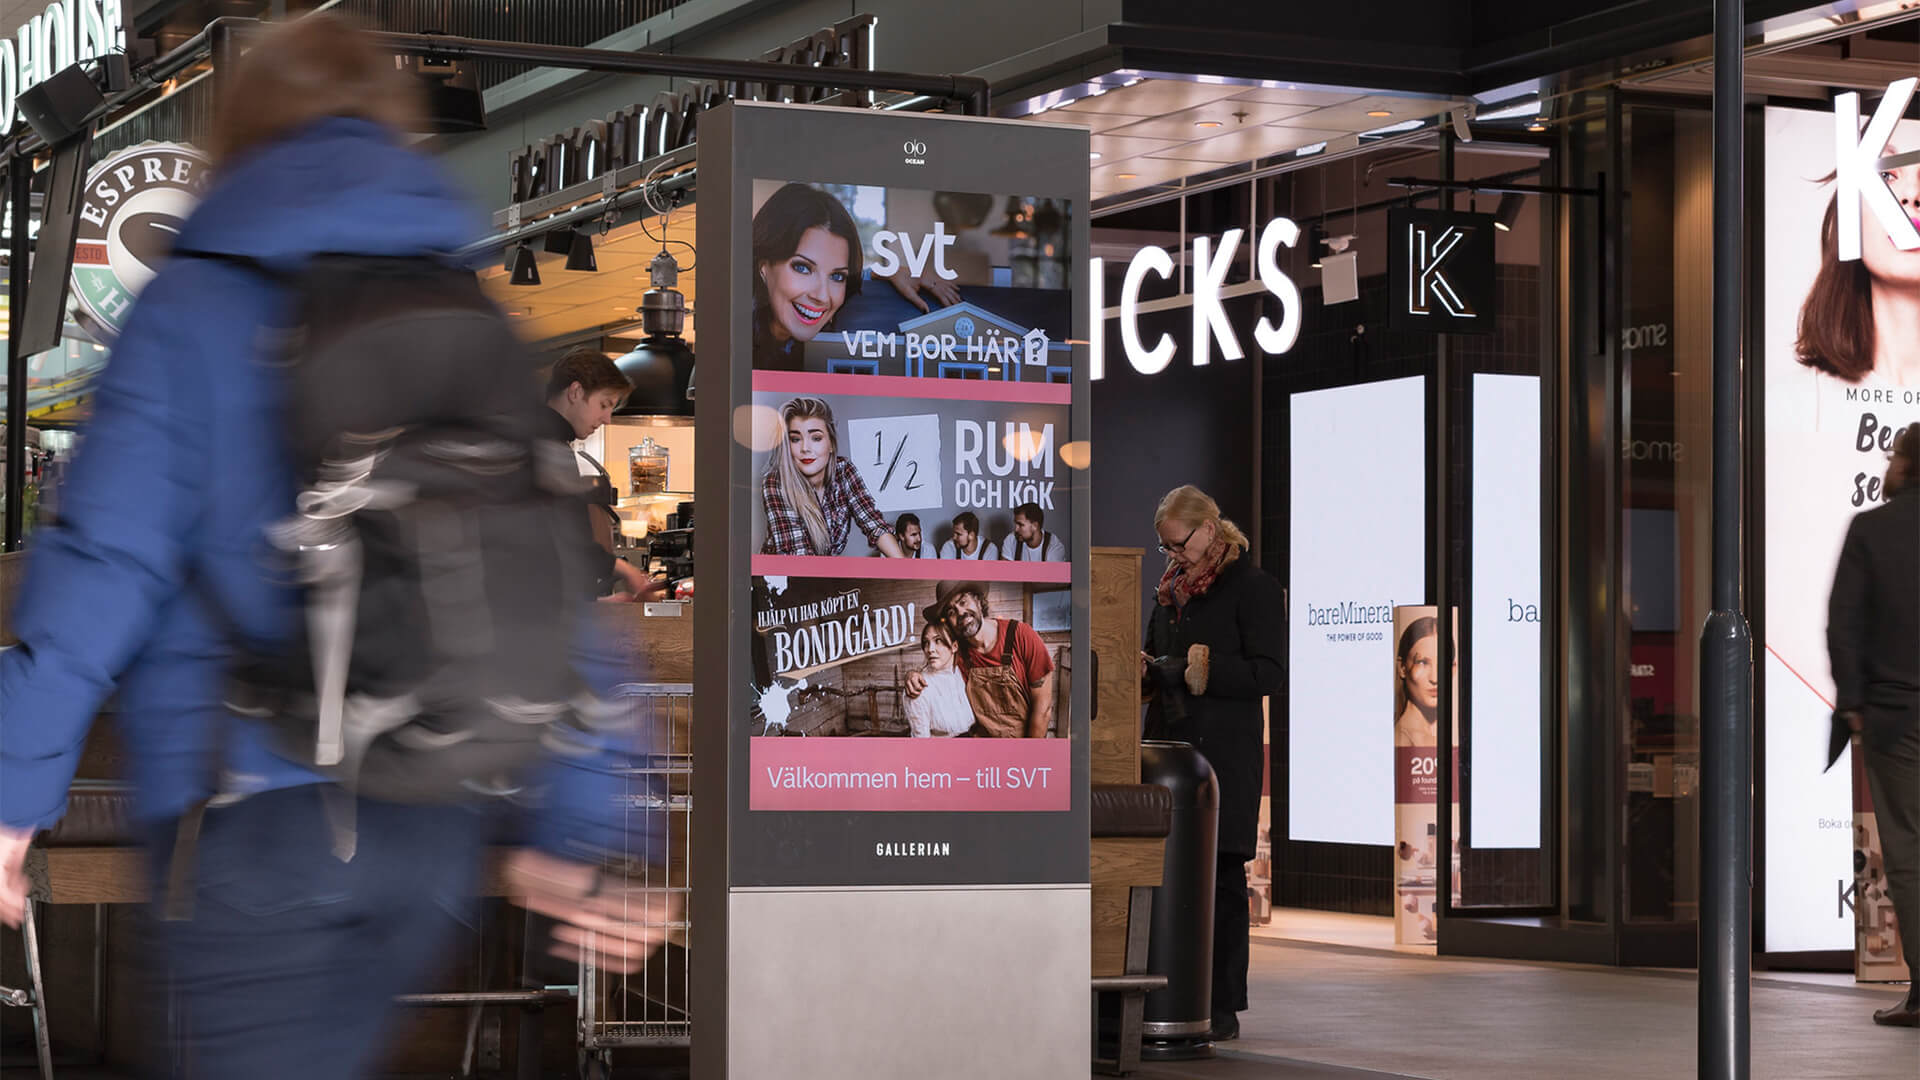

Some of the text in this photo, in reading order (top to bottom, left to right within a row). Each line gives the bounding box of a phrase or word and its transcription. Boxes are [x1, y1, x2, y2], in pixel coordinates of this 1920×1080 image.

[1834, 76, 1920, 262] K
[870, 222, 959, 281] svt
[1409, 222, 1478, 318] K
[842, 330, 897, 359] VEM
[906, 333, 957, 361] BOR
[1846, 388, 1894, 403] MORE
[955, 420, 1055, 478] RUM
[955, 479, 1055, 511] OCH KÖK
[758, 591, 860, 628] HJÄLP VI HAR KÖPT EN
[774, 602, 916, 674] BONDGÅRD!
[1326, 631, 1384, 642] THE POWER OF GOOD
[767, 766, 898, 789] Välkommen
[904, 766, 952, 789] hem
[975, 766, 1002, 789] till
[1005, 767, 1053, 789] SVT
[1411, 757, 1437, 775] 20
[876, 842, 951, 856] GALLERIAN
